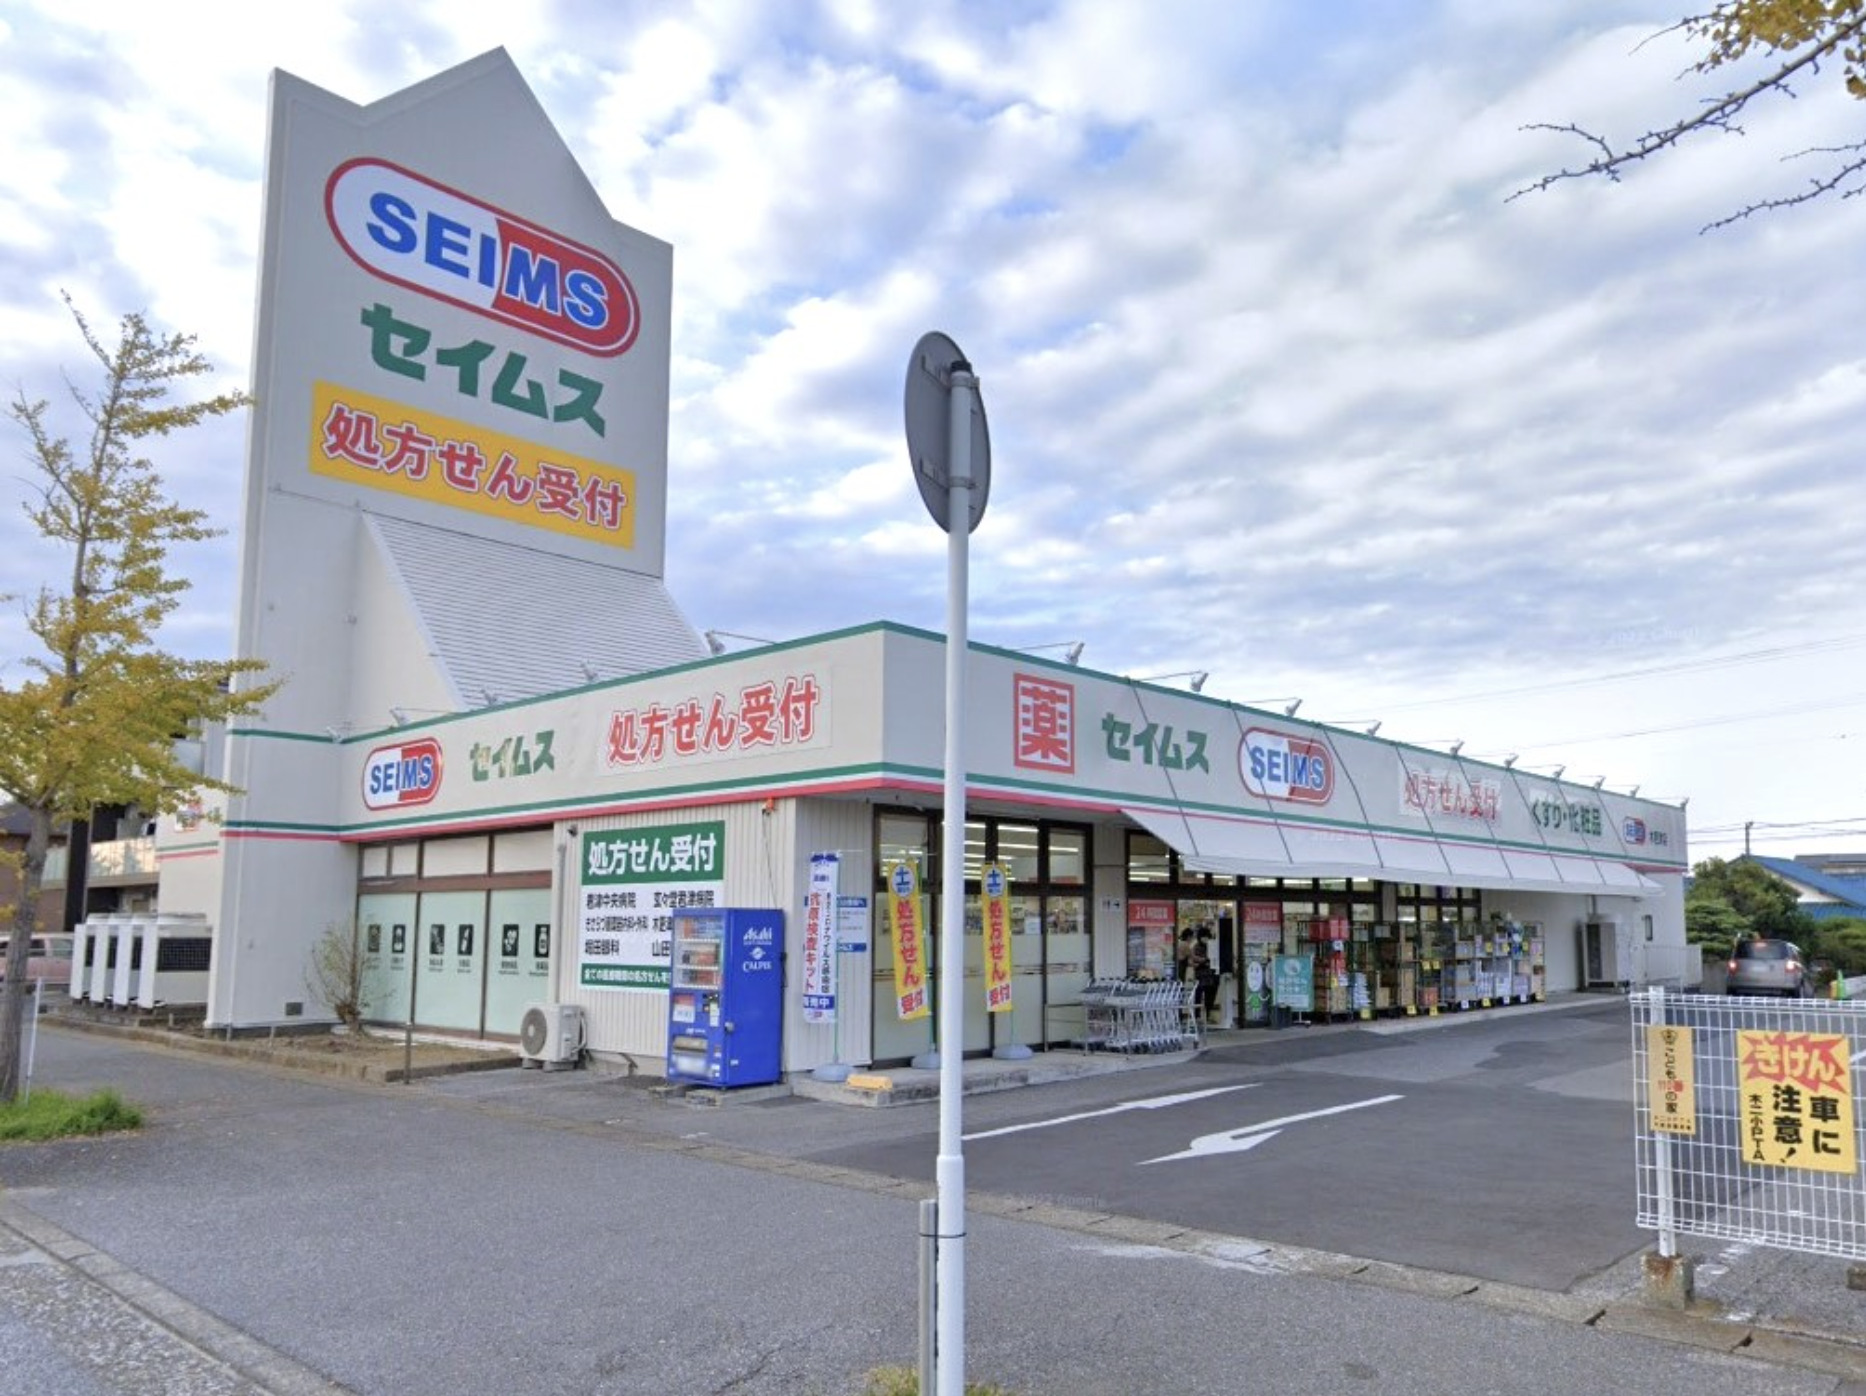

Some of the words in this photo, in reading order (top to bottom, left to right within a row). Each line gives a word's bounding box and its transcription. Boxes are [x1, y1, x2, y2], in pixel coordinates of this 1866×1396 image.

[366, 192, 609, 329] SEIMS
[360, 303, 605, 438] セイムス
[323, 404, 626, 530] 処方せん受付
[608, 673, 819, 767] 処方せん受付
[1017, 680, 1072, 768] 薬
[1101, 711, 1209, 774] セイムス
[369, 751, 434, 795] SEIMS
[470, 729, 555, 782] セイムス
[1250, 745, 1325, 790] SEIMS
[588, 833, 717, 876] 処方せん受付
[743, 928, 772, 940] Asahi
[1754, 1043, 1836, 1083] きけん
[1810, 1095, 1842, 1156] 車に
